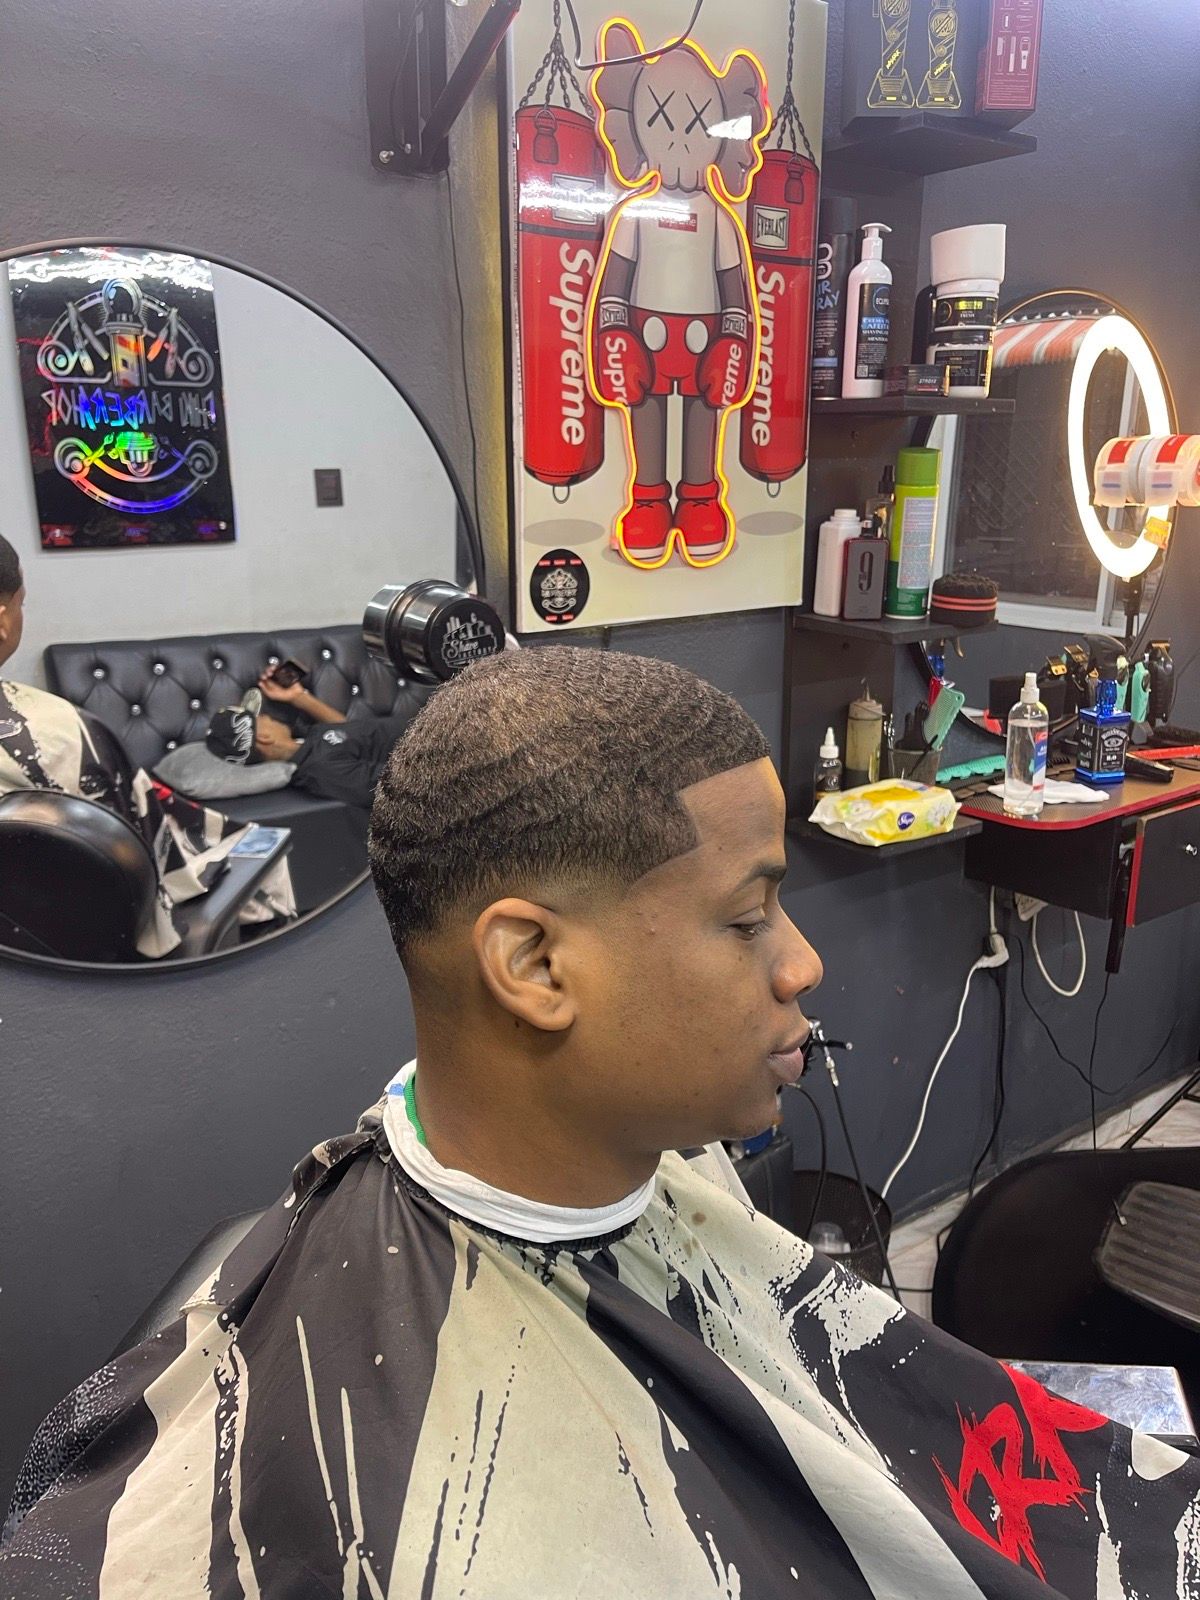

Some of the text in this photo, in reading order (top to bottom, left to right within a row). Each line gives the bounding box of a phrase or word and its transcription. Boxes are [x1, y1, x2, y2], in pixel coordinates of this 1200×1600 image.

[757, 212, 786, 241] EVERLAST
[549, 242, 596, 446] Supreme
[816, 290, 840, 311] RAY
[752, 265, 786, 446] Supreme
